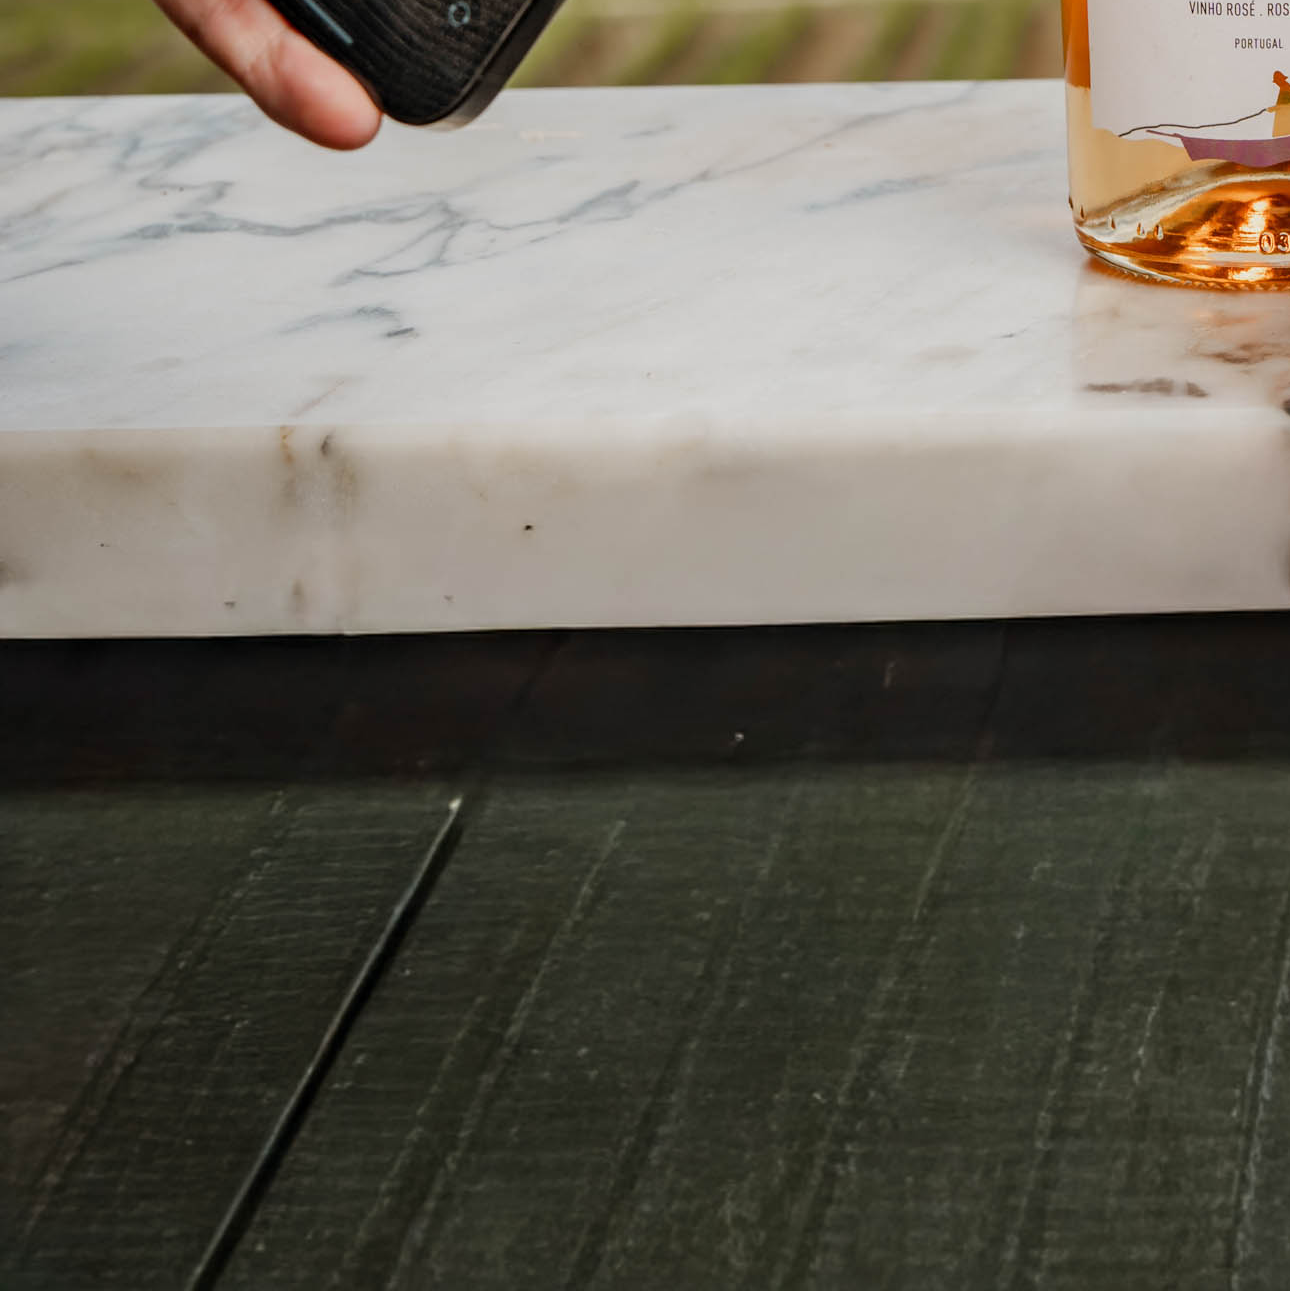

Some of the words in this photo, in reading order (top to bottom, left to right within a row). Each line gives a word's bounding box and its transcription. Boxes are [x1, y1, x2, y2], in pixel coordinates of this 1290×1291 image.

[1189, 0, 1223, 16] VINHO
[1226, 0, 1256, 17] ROSÉ
[1234, 37, 1284, 50] PORTUGAL
